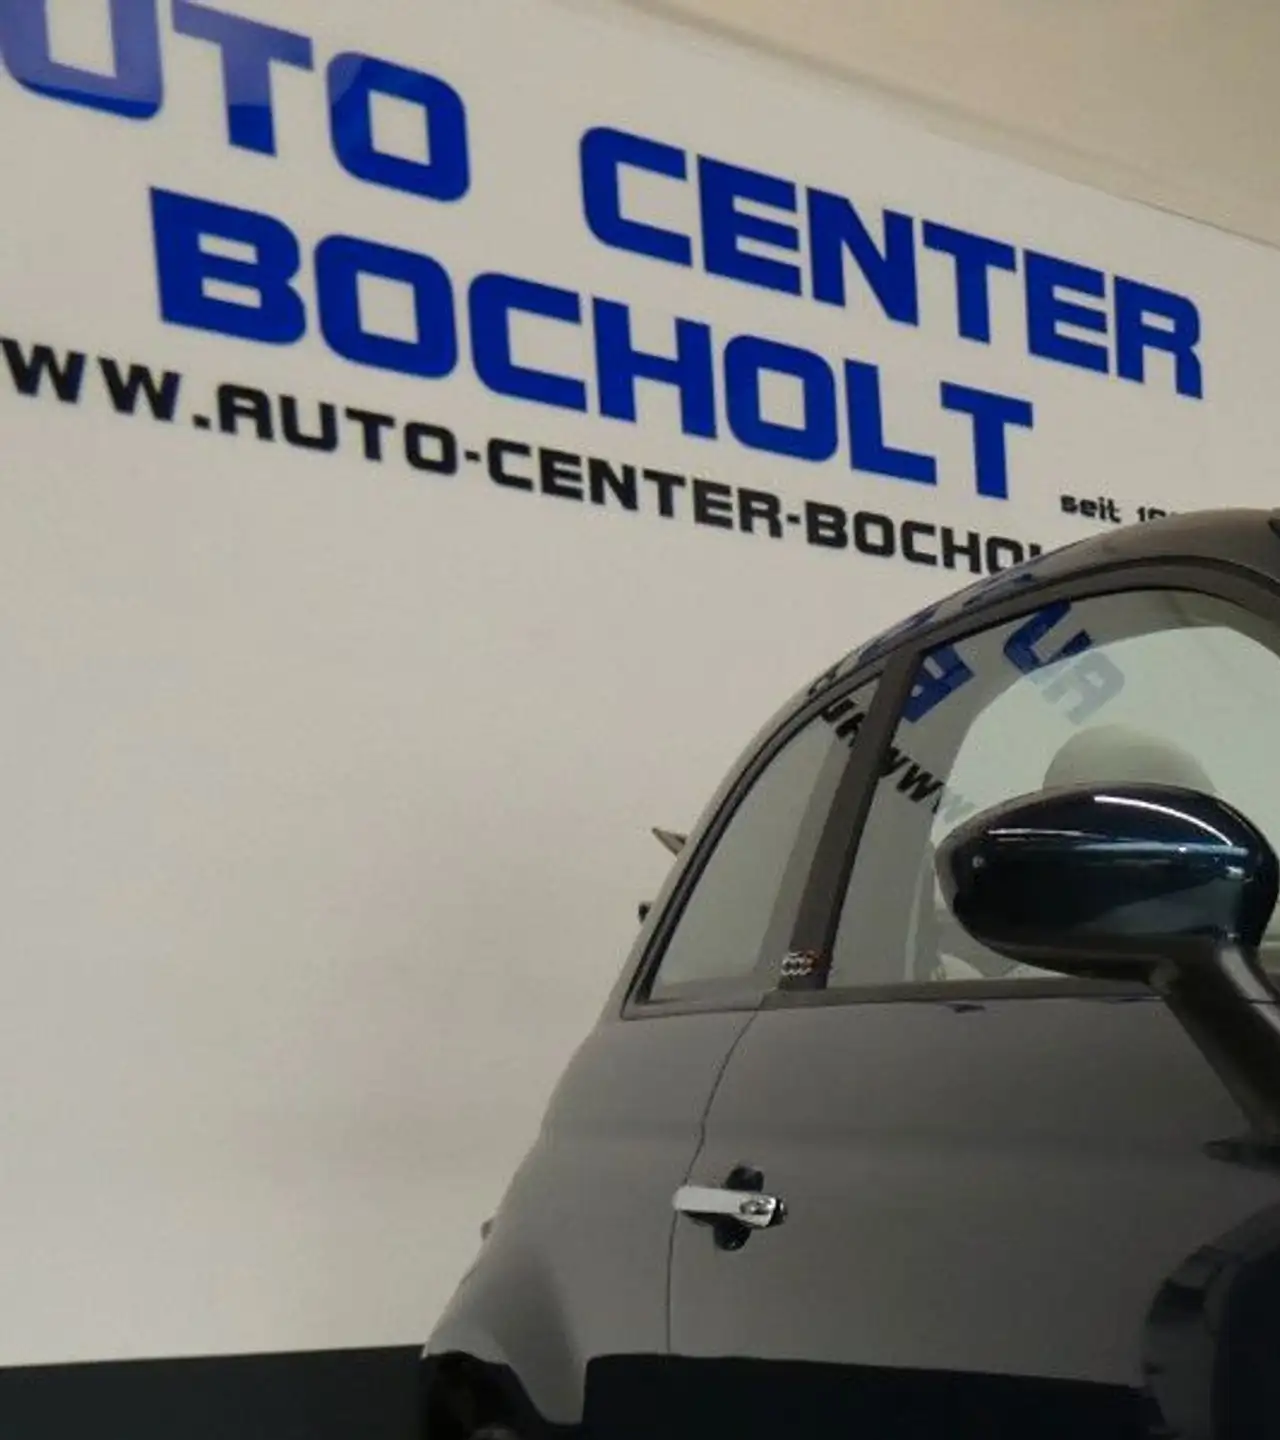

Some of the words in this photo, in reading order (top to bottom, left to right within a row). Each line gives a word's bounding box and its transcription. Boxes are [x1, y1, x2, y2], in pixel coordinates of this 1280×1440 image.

[150, 188, 1033, 500] BOCHOLT
[580, 128, 1202, 398] CENTER
[1061, 495, 1120, 523] seit
